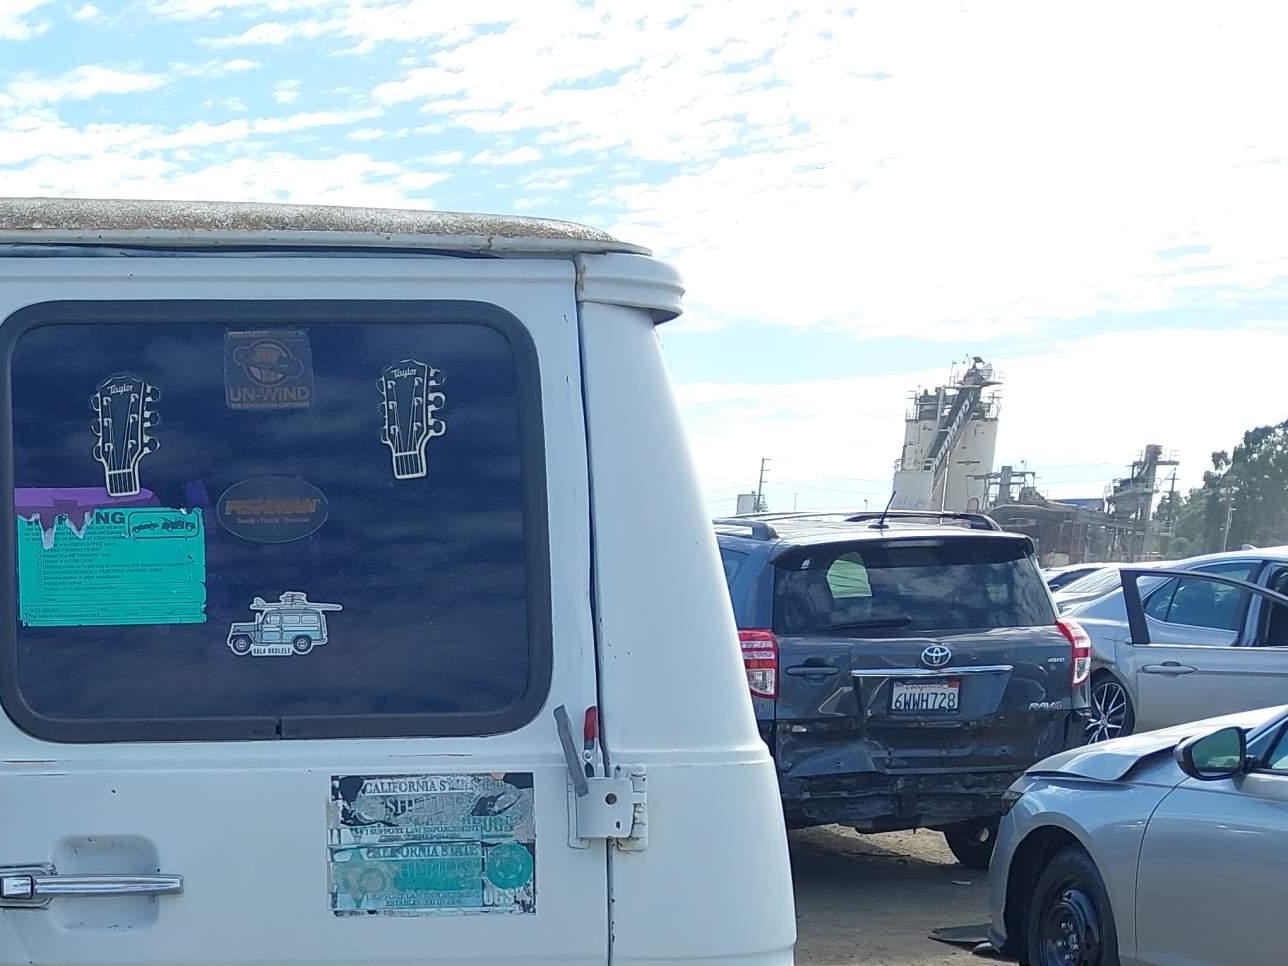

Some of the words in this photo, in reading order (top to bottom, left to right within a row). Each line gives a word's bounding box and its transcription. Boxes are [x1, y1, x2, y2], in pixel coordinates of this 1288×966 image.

[390, 366, 417, 379] Taylor
[106, 383, 133, 395] Taylor
[229, 387, 310, 402] UN-WIND
[894, 692, 956, 709] 6WWH728
[364, 780, 438, 796] CALIFORNIA
